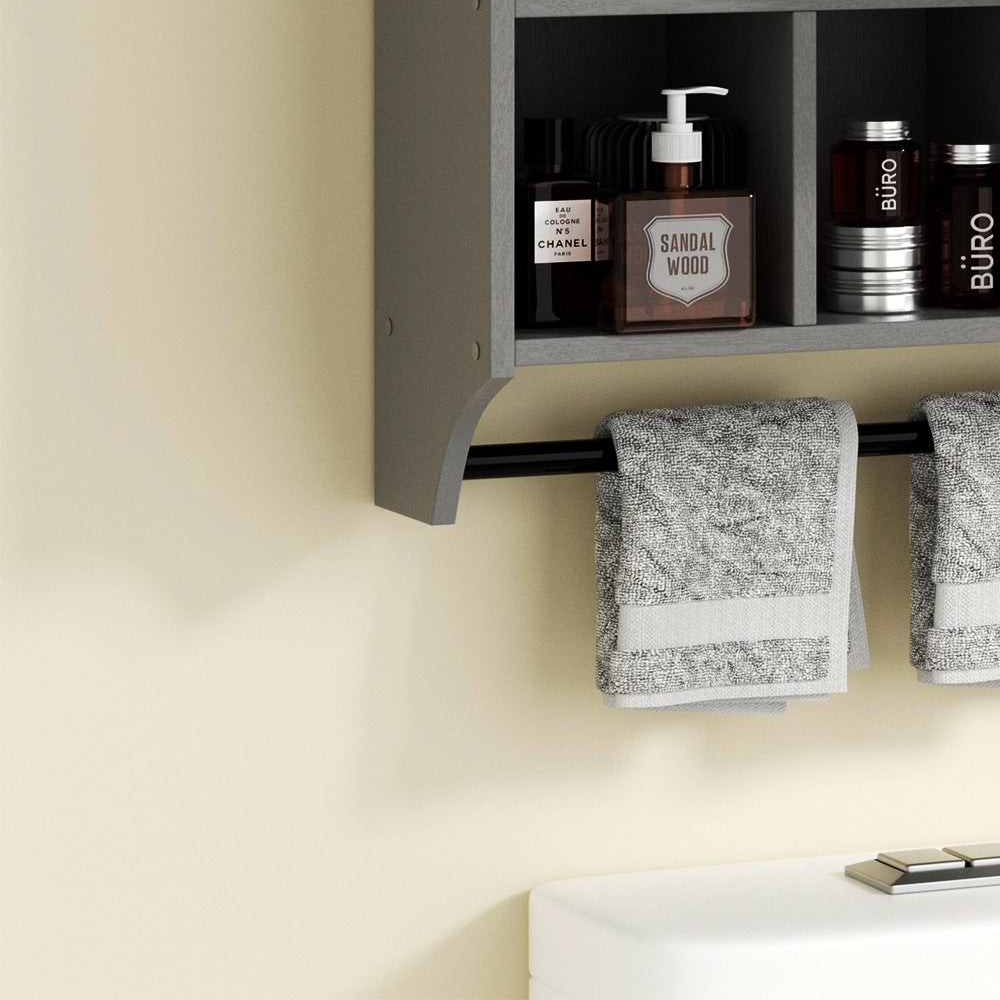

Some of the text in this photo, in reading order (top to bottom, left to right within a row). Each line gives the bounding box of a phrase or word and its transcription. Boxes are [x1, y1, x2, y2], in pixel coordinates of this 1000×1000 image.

[875, 158, 897, 211] BÜRO
[537, 239, 588, 249] CHANEL
[660, 232, 716, 253] SANDAL
[960, 212, 994, 290] BÜRO
[667, 256, 709, 276] WOOD
